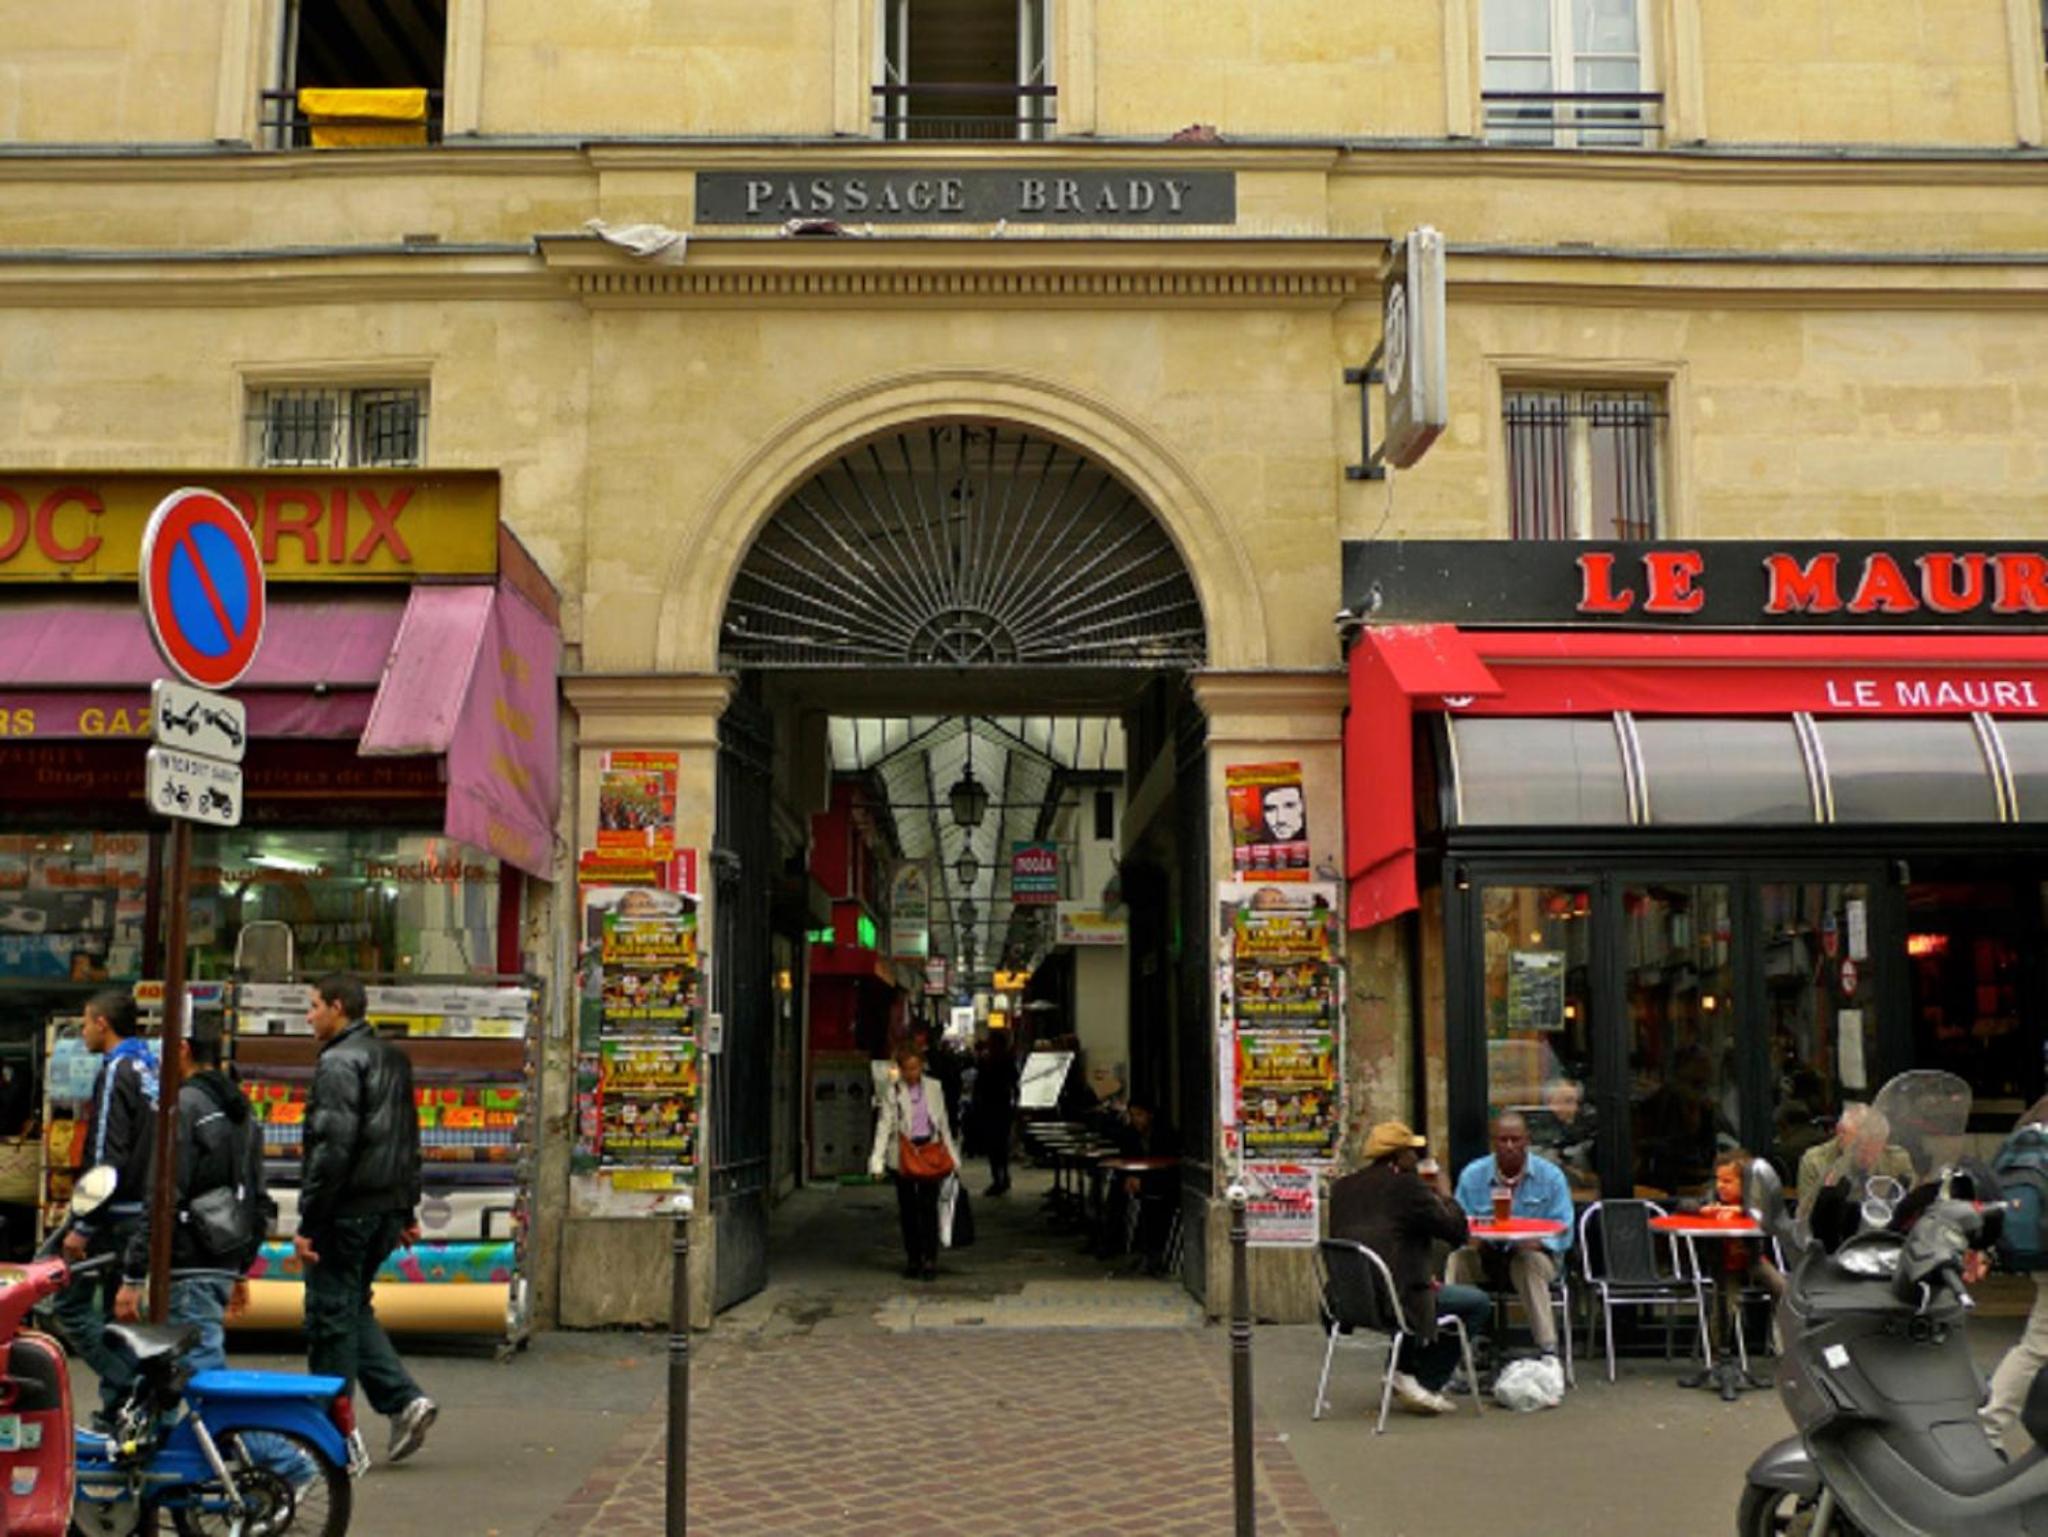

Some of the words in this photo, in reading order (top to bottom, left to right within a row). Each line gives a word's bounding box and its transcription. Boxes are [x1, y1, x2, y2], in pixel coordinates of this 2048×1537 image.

[744, 177, 967, 215] PASSAGE
[1017, 177, 1192, 214] BRADY
[1576, 551, 1705, 614] LE
[1763, 551, 2048, 614] MAUR
[1825, 679, 1882, 708] LE
[1894, 679, 2039, 708] MAURI
